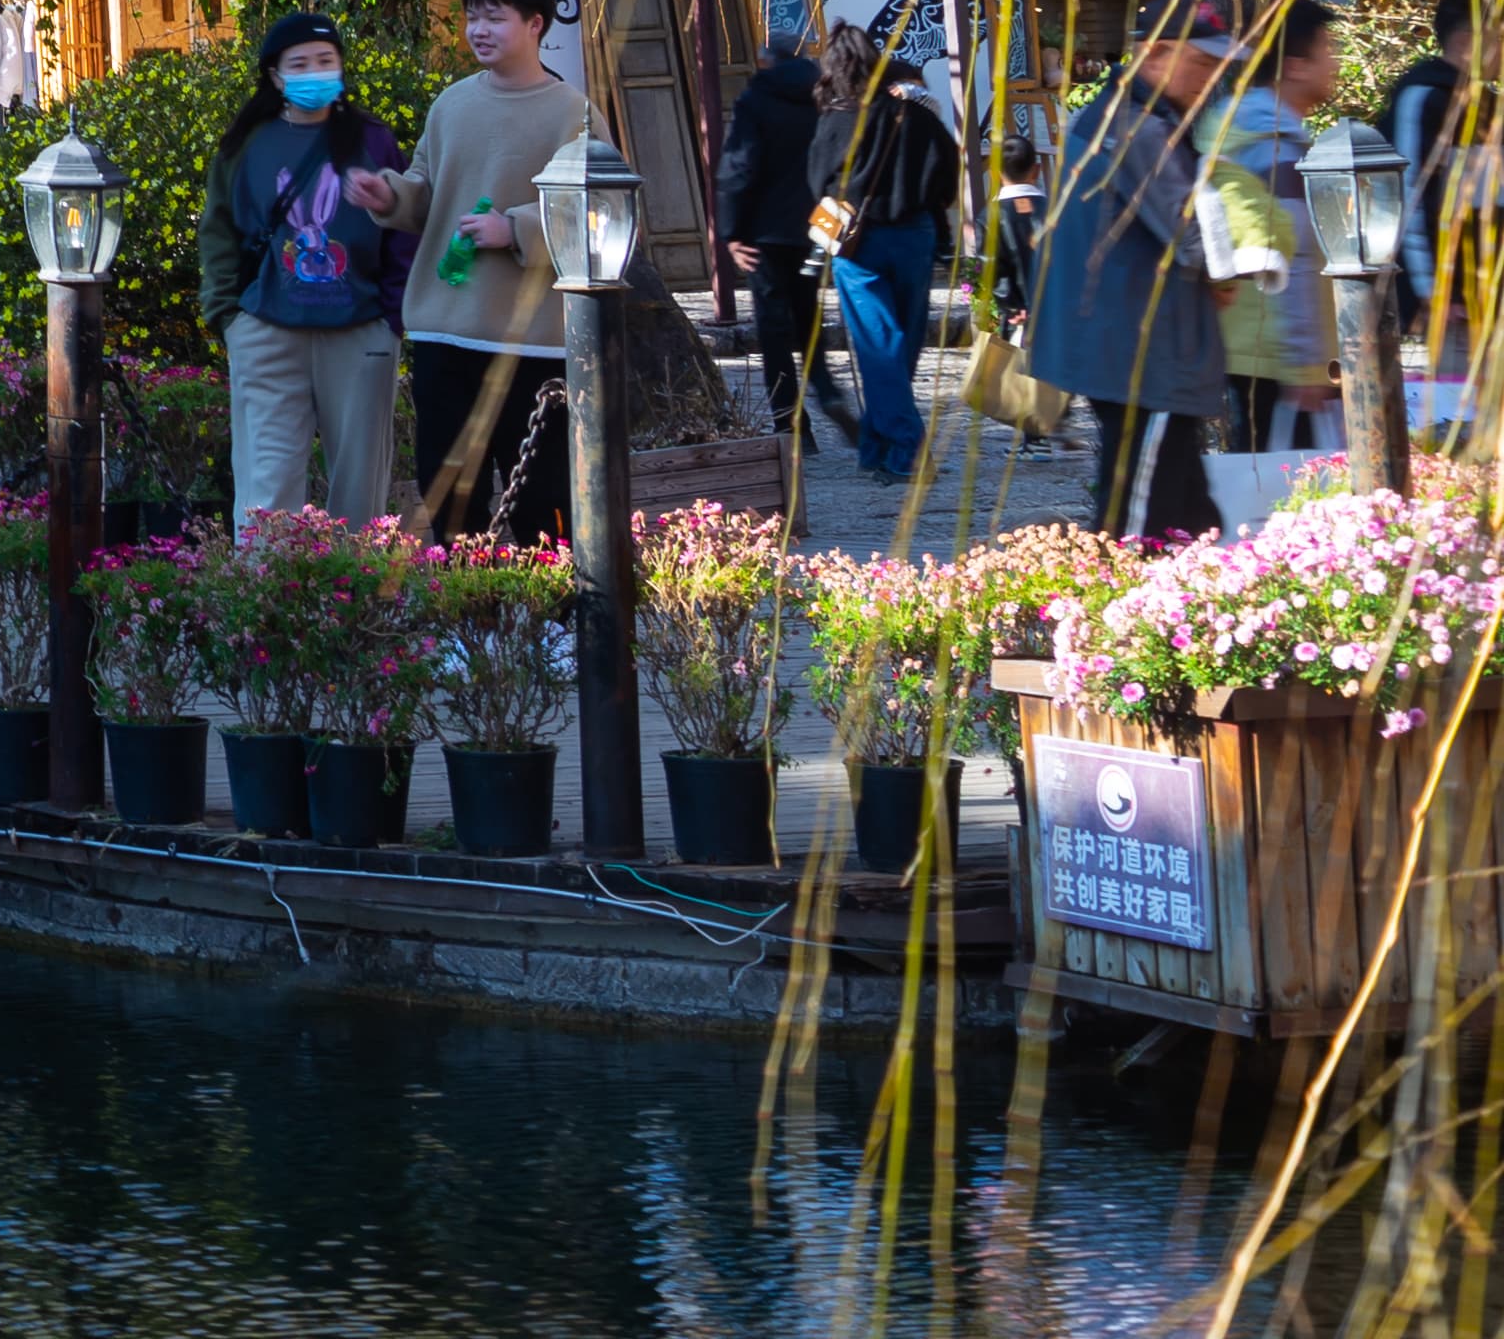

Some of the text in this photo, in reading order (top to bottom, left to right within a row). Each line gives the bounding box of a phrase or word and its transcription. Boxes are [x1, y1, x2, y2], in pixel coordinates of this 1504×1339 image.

[1051, 824, 1191, 886] 保护河道环境
[1053, 867, 1193, 932] 共创美好家园
